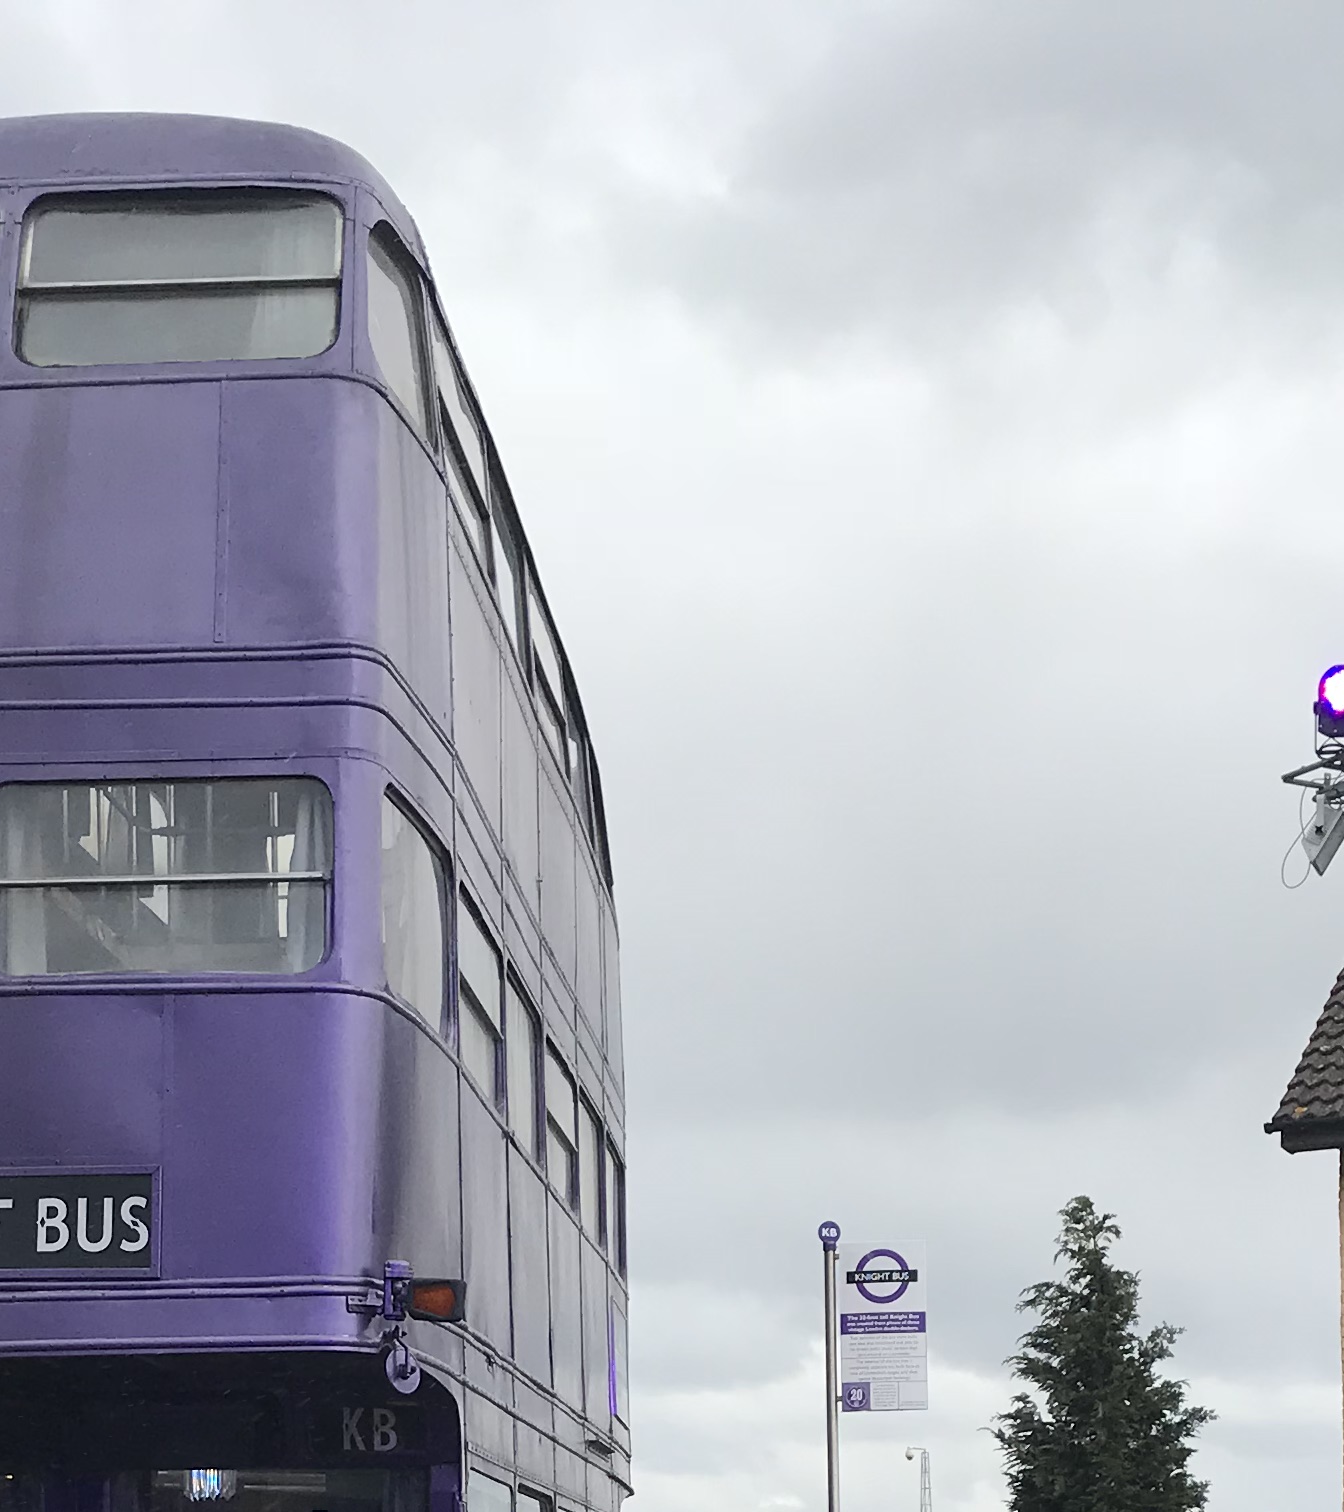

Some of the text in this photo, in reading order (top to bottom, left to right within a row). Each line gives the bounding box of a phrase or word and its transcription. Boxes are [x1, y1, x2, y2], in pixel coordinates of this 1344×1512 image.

[36, 1196, 150, 1253] BUS
[821, 1227, 838, 1238] KB
[854, 1271, 910, 1281] KNIGHT BUS
[850, 1388, 863, 1401] 20
[342, 1407, 397, 1452] KB
